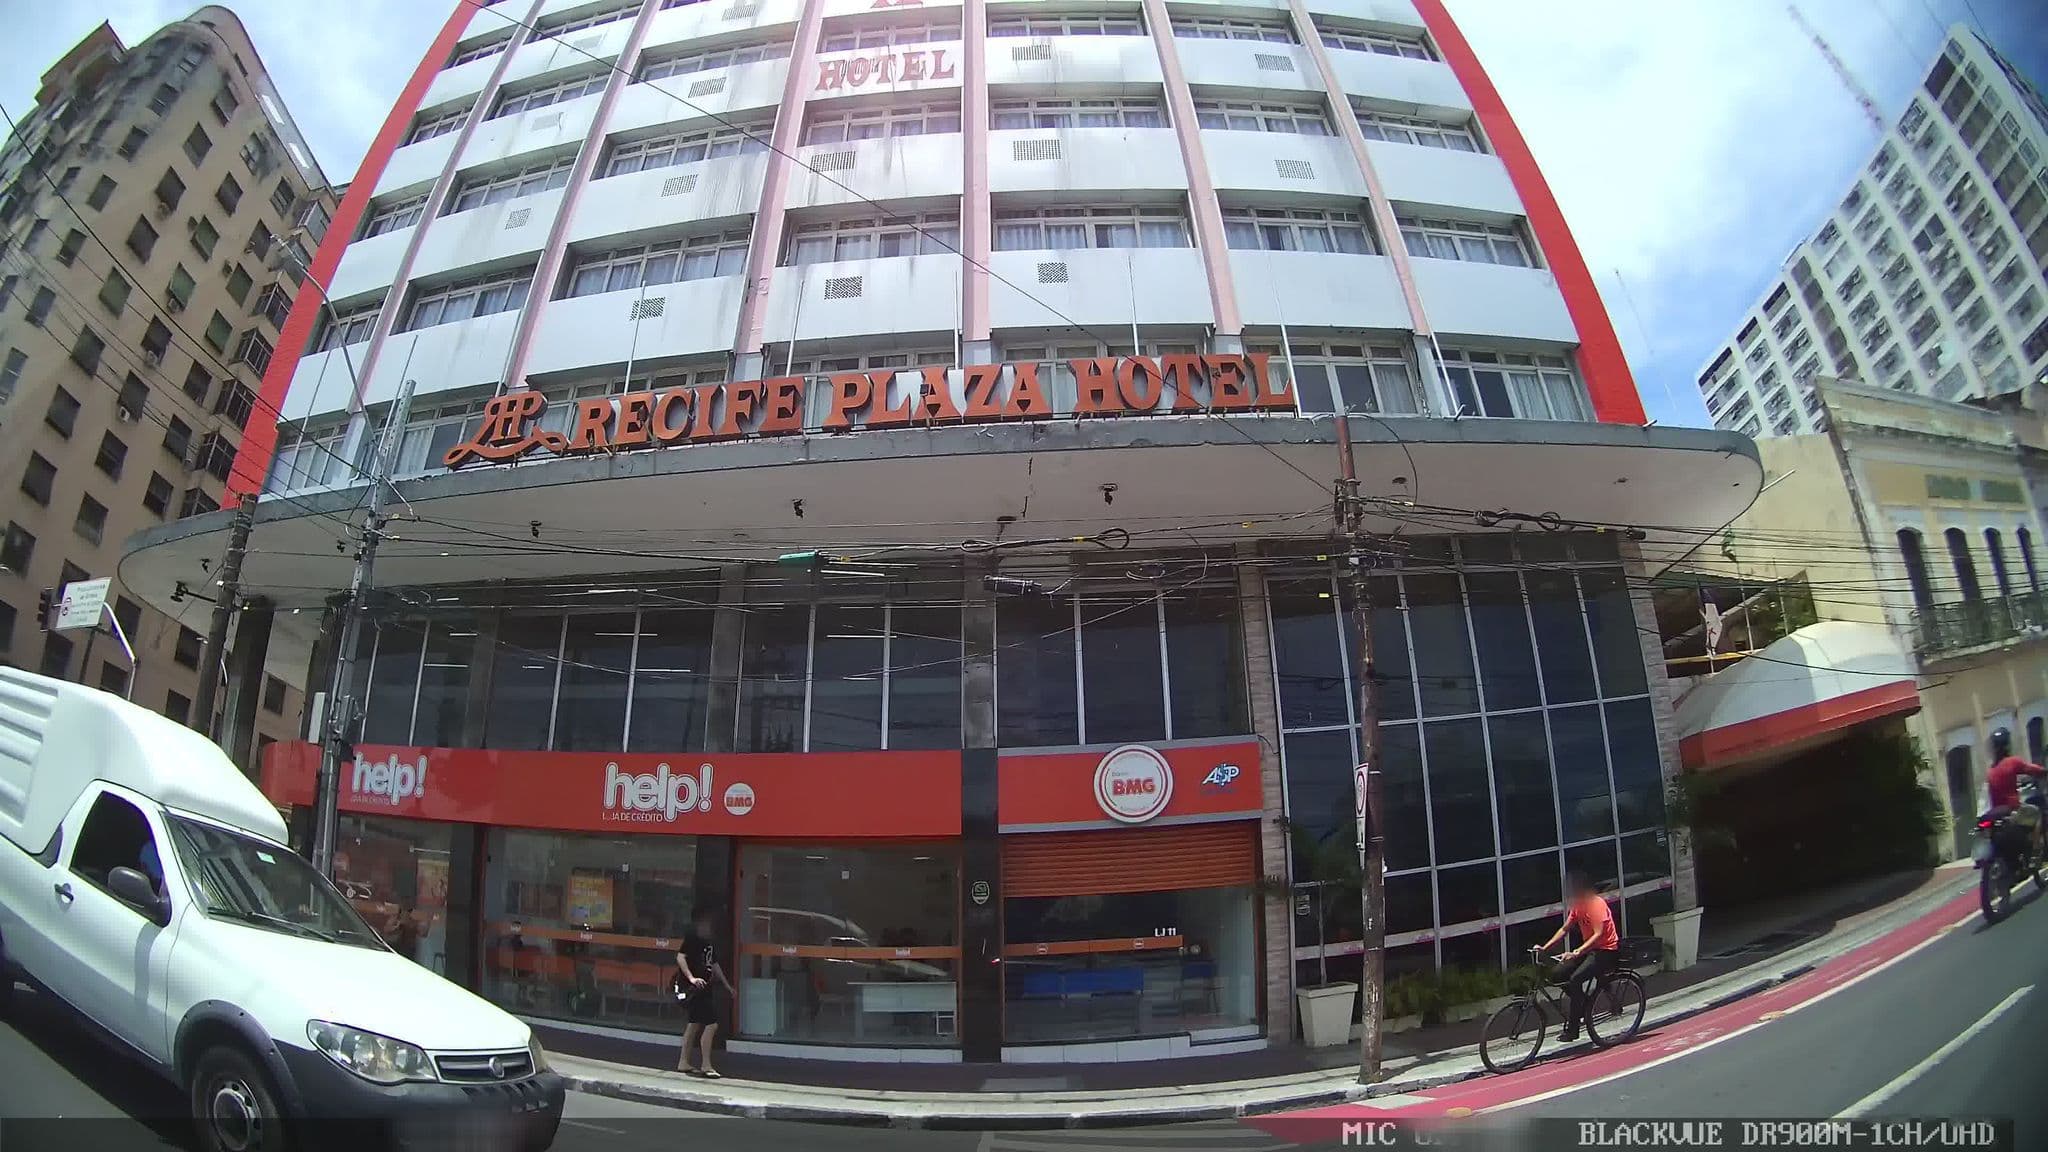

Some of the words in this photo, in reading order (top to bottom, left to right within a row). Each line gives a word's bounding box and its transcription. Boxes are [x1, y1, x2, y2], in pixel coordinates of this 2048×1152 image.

[815, 50, 955, 91] HOTEL
[569, 376, 805, 449] RECIFE
[822, 362, 1053, 428] PLAZA
[1067, 352, 1298, 412] HOTEL
[352, 752, 428, 806] help!
[604, 762, 714, 822] help!
[1112, 777, 1156, 796] BMG
